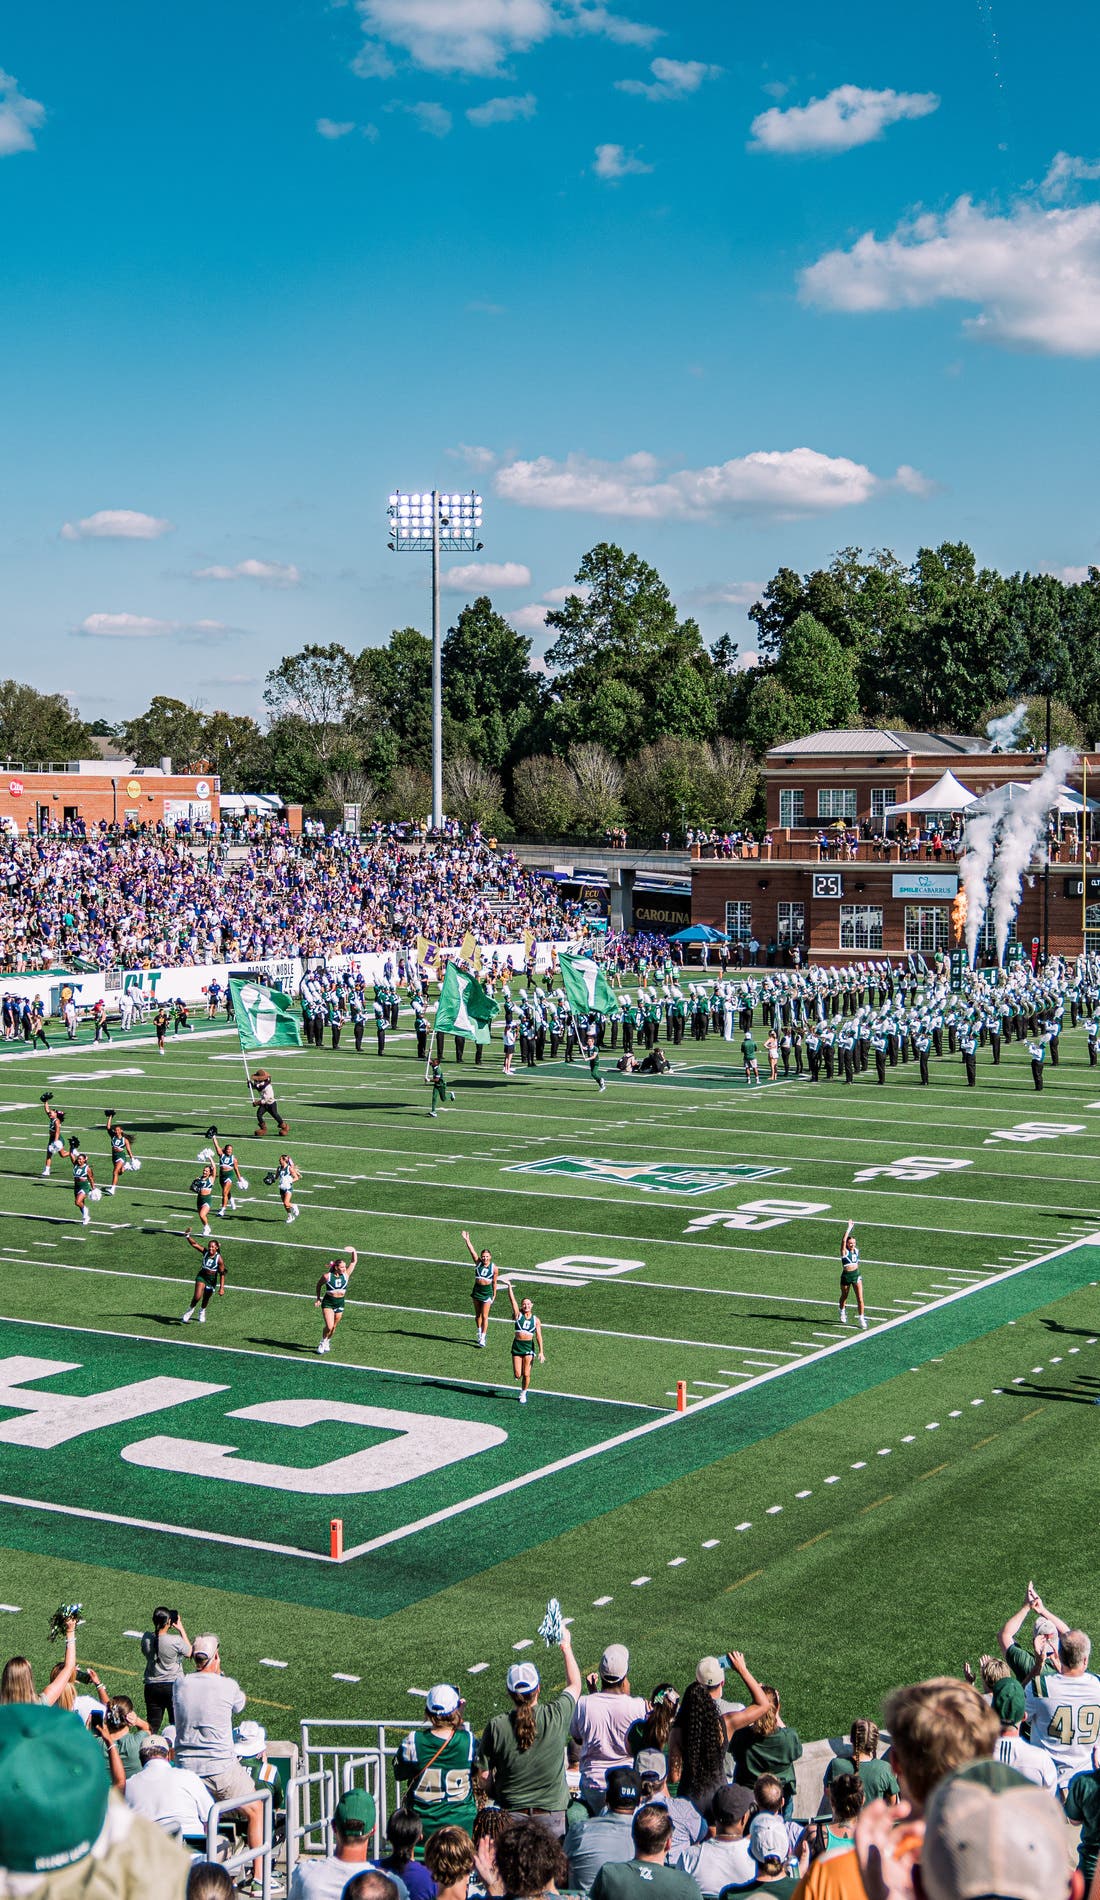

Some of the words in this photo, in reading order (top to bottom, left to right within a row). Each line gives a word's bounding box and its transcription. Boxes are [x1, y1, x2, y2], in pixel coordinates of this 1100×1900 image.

[584, 890, 600, 898] ECU
[817, 877, 838, 895] 25
[636, 908, 691, 924] CAROLINA
[276, 963, 294, 976] NOBLE
[989, 1121, 1088, 1143] 40
[854, 1155, 975, 1181] 30
[687, 1199, 833, 1231] 20
[497, 1255, 647, 1287] 10
[1047, 1704, 1100, 1745] 49
[414, 1768, 471, 1802] 49
